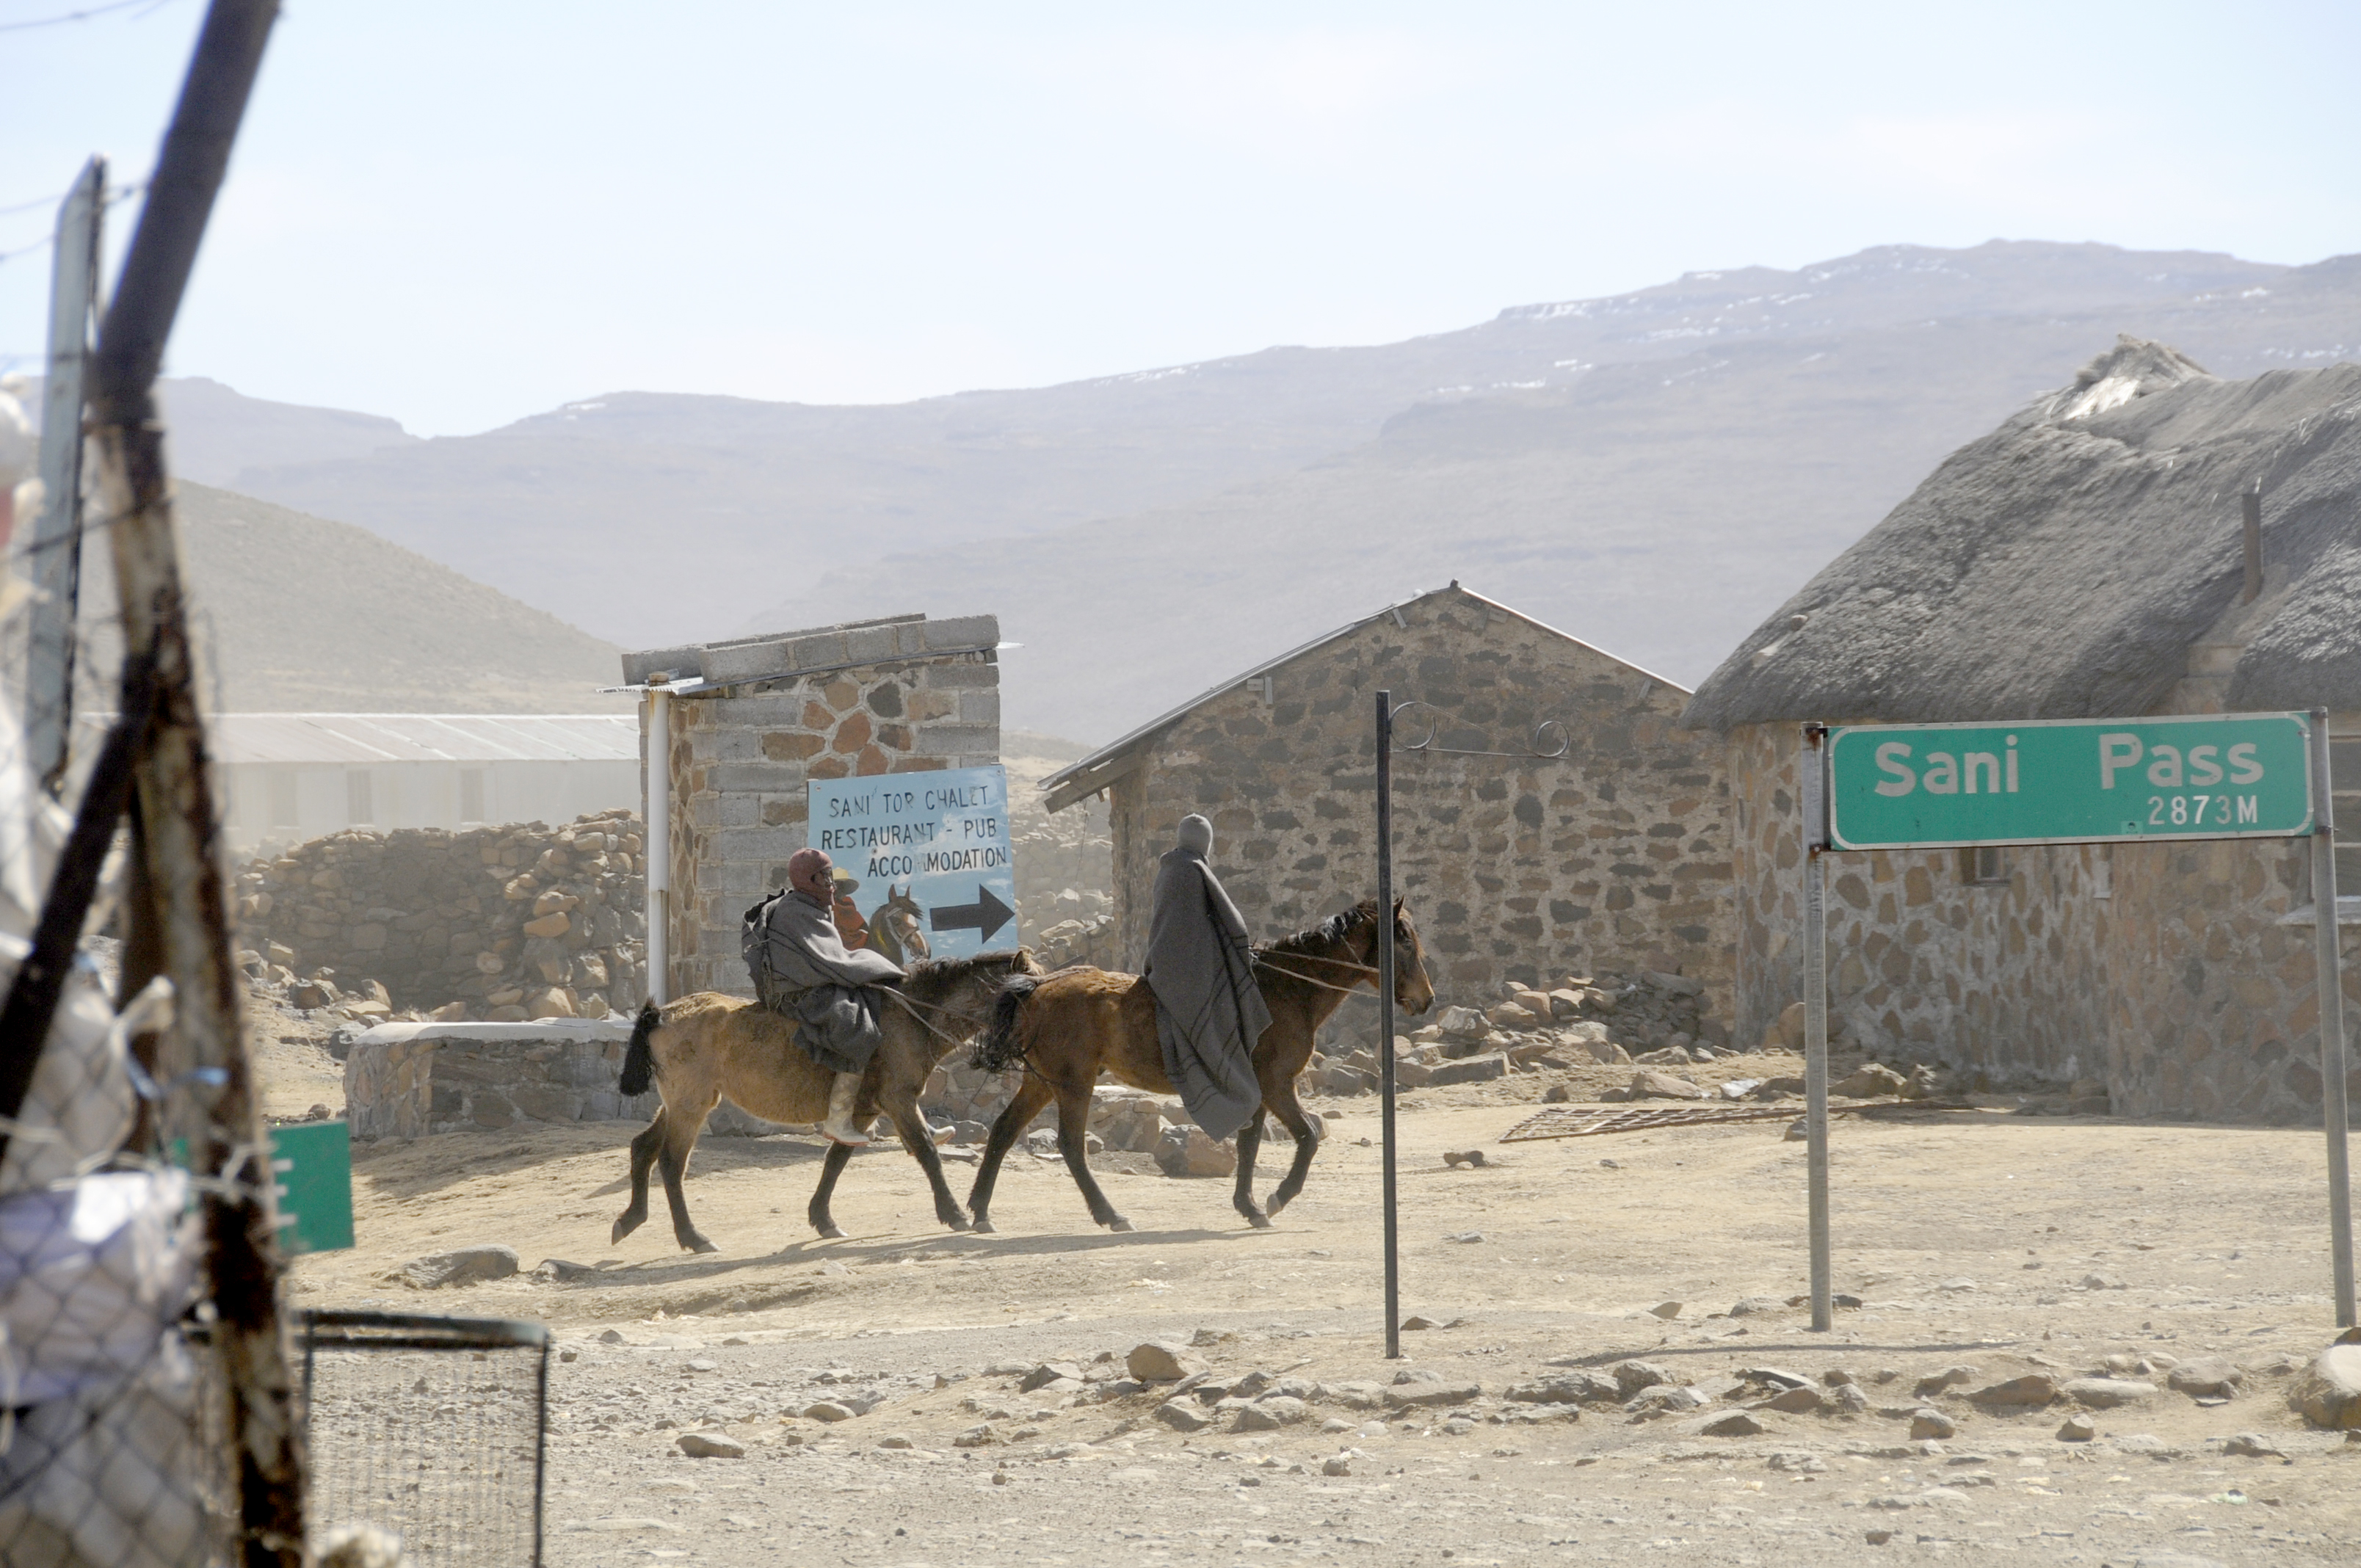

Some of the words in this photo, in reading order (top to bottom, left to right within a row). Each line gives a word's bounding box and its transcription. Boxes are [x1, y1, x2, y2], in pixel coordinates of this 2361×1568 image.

[1874, 733, 2020, 797] Sani
[2099, 733, 2265, 789] Pass
[829, 795, 870, 818] SANI
[883, 792, 914, 813] TOP
[925, 785, 988, 810] CHALET
[2147, 794, 2258, 825] 2873M
[822, 822, 935, 850] RESTAURANT
[964, 818, 997, 839] PUB
